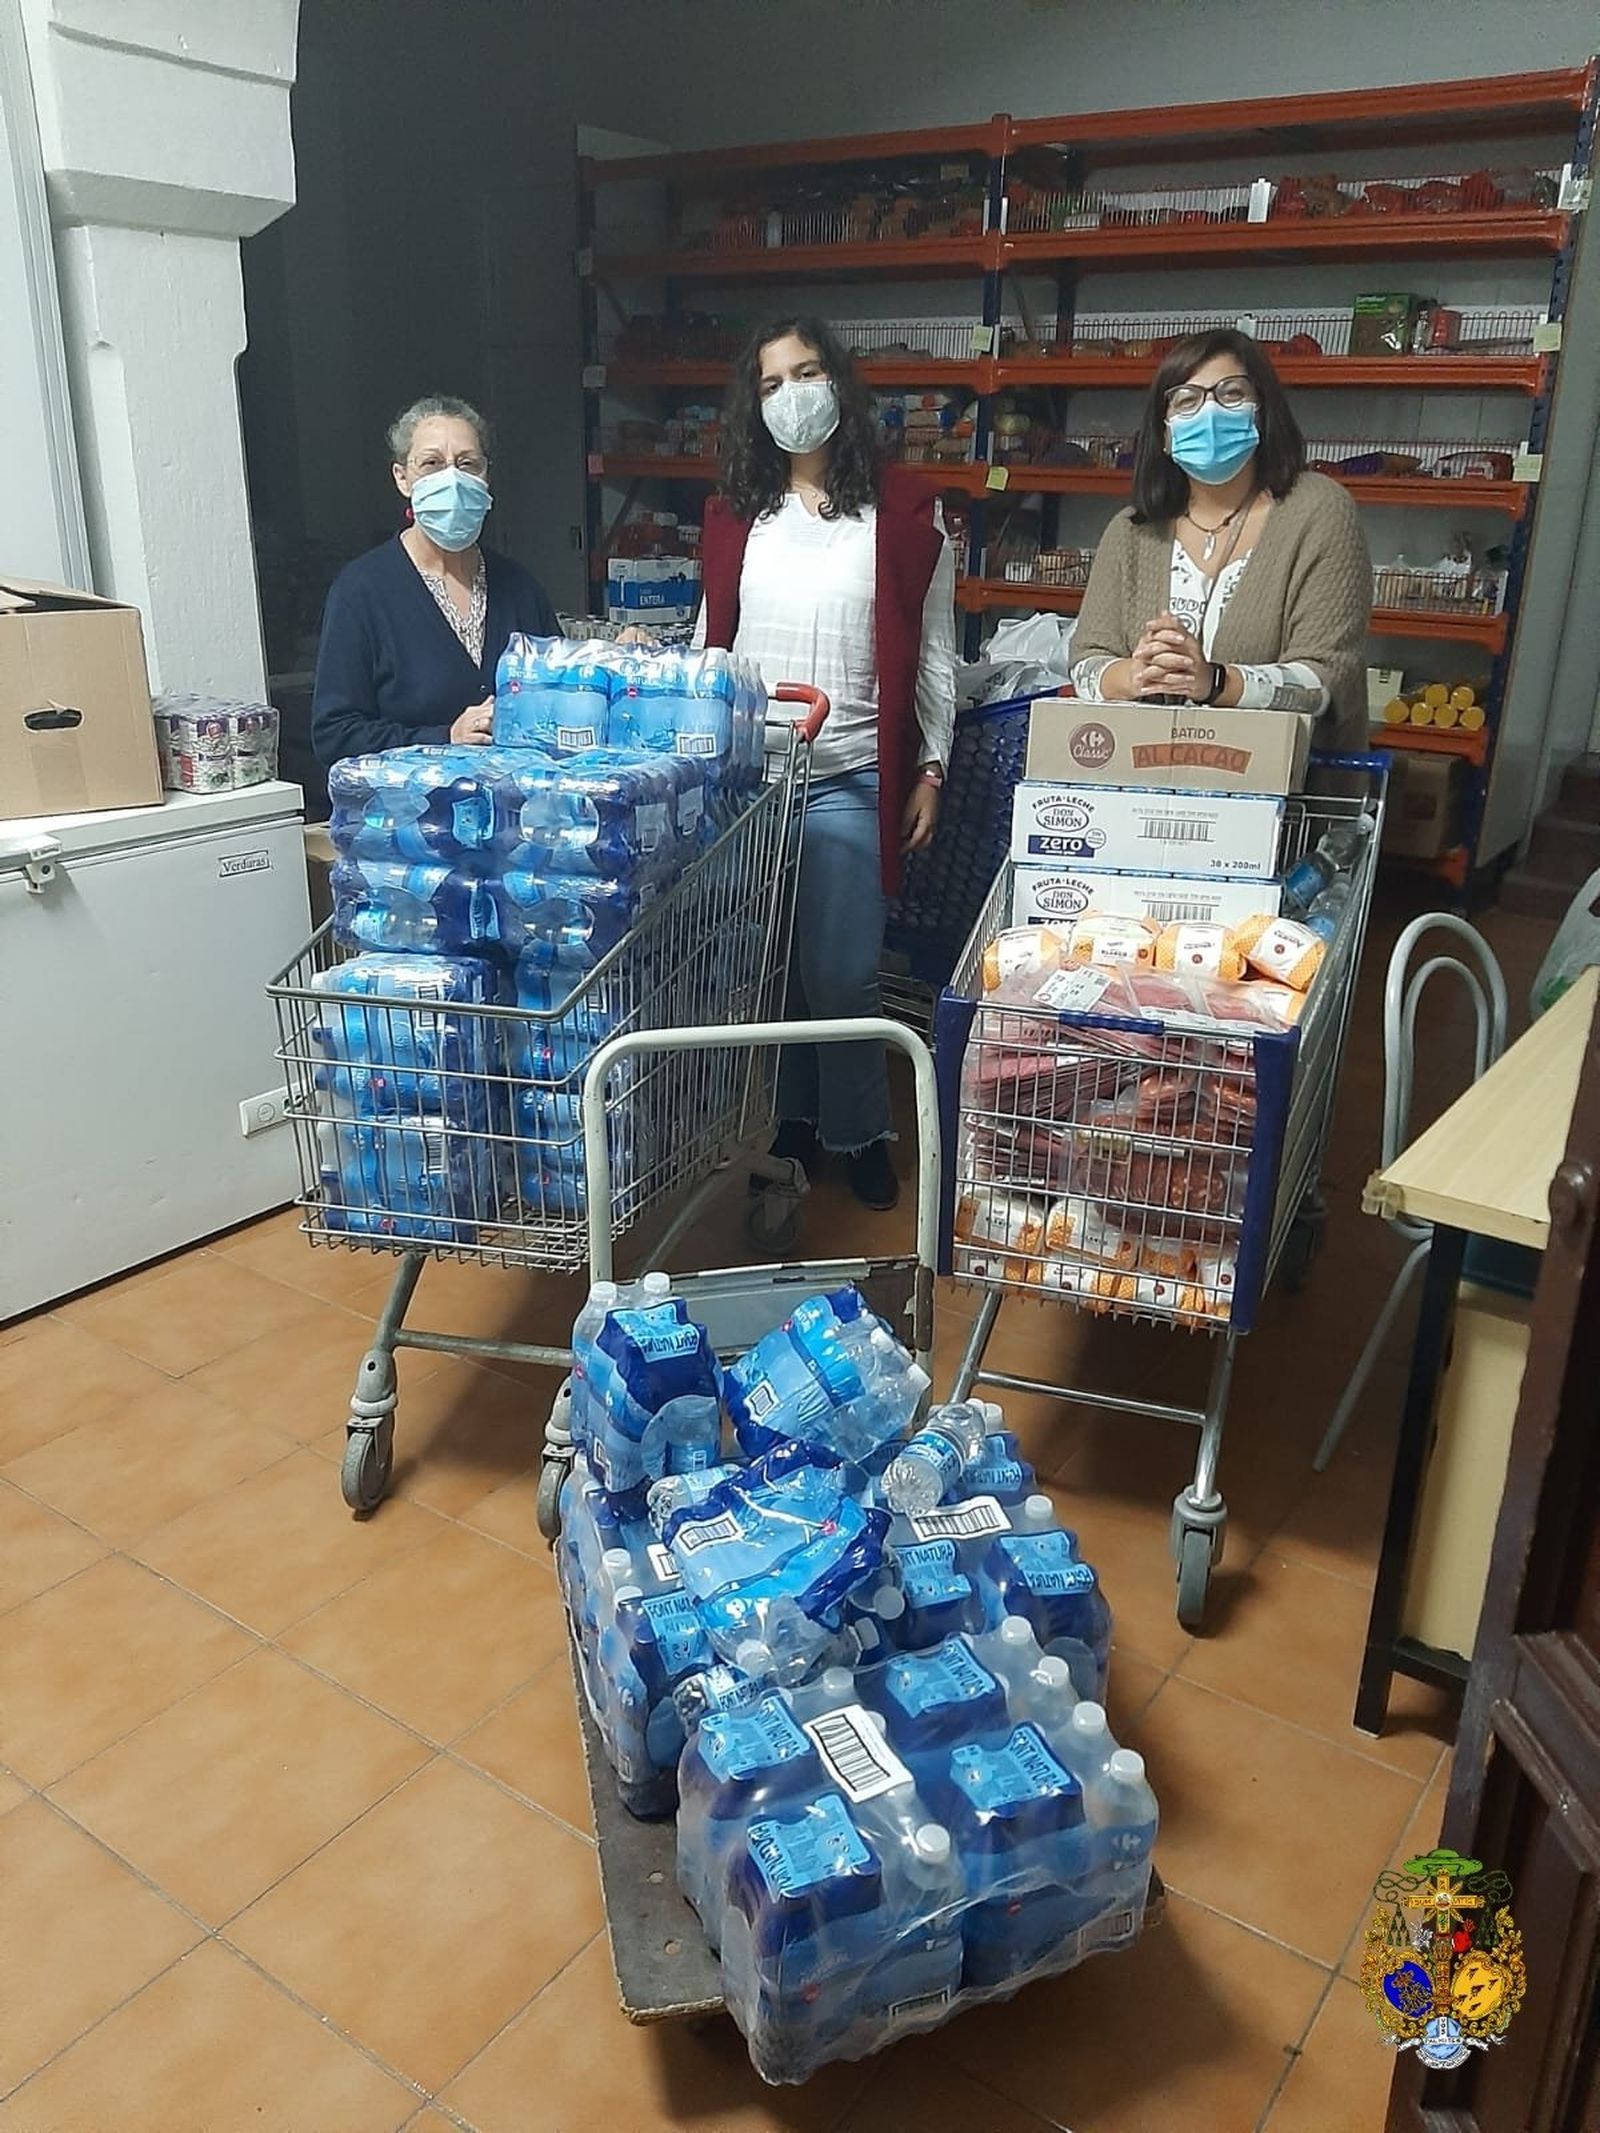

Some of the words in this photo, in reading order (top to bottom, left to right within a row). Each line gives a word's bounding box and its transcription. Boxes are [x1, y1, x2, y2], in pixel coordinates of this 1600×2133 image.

[1171, 728, 1215, 740] BATIDO
[1073, 744, 1112, 759] Classic
[1137, 747, 1164, 764] AL
[1170, 745, 1247, 768] CACAO
[1053, 808, 1074, 816] DON
[1043, 815, 1083, 827] SIMON
[1040, 837, 1083, 851] zero
[223, 857, 266, 872] Verduras
[1232, 861, 1261, 870] 200ml
[1052, 890, 1073, 899] DON
[1043, 897, 1082, 910] SIMON
[647, 1600, 674, 1618] FONT
